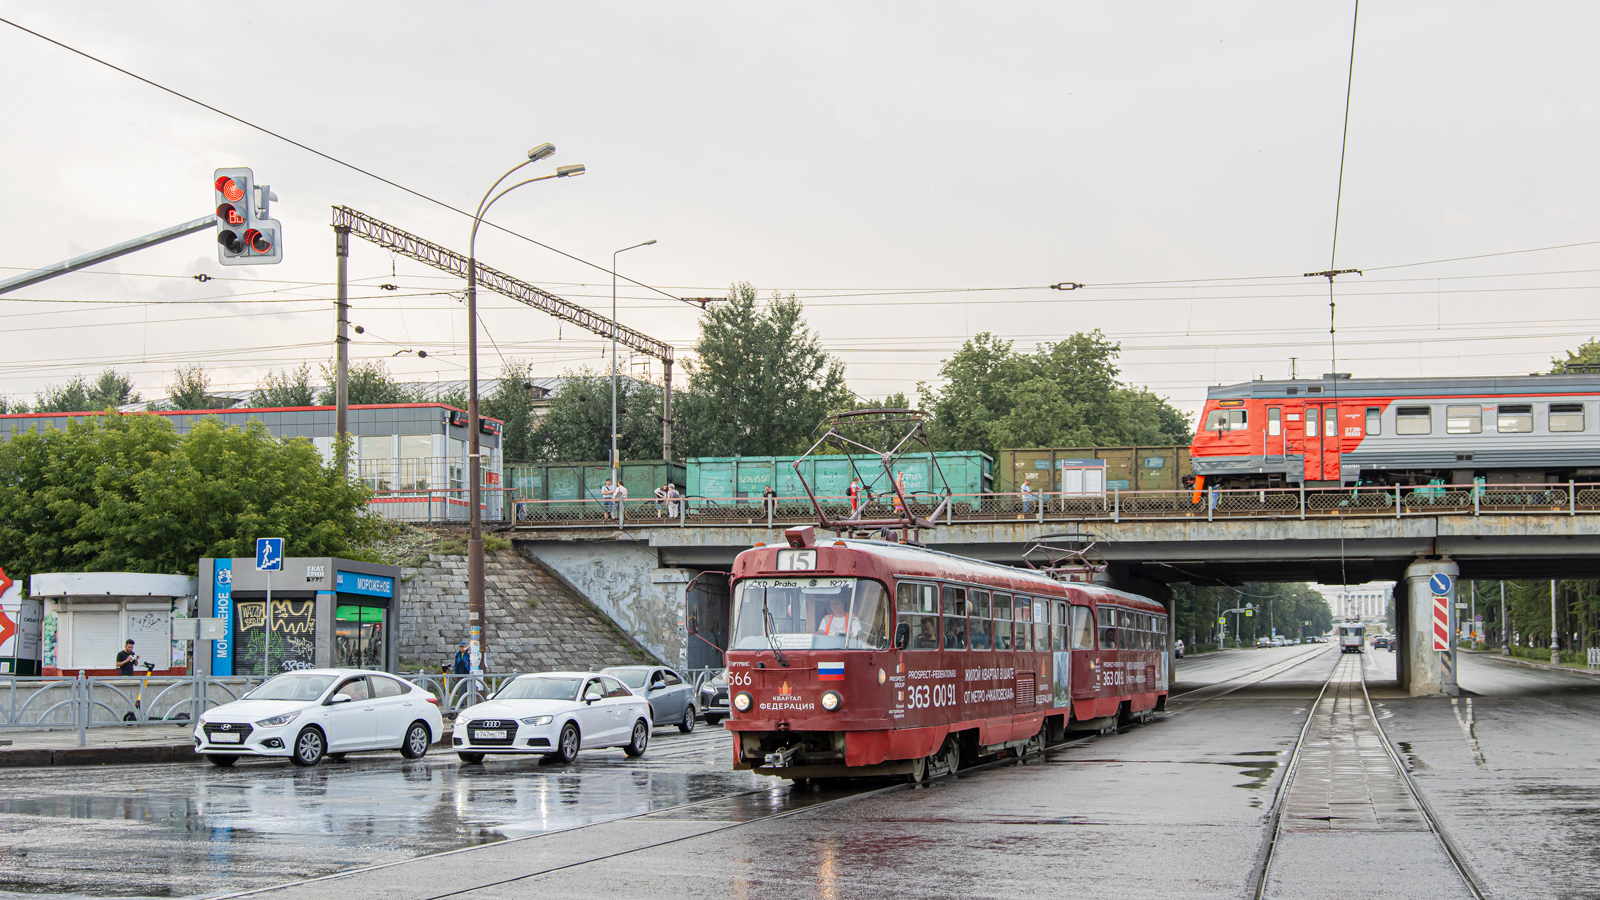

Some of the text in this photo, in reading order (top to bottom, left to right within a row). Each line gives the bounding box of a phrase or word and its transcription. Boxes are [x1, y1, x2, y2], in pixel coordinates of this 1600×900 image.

[788, 552, 810, 570] 15
[357, 578, 390, 593] МОРОЖЕНОЕ
[774, 580, 797, 588] Praha
[981, 668, 1000, 681] КВАРТАЛ
[907, 685, 930, 709] 363
[970, 690, 986, 704] МЕТРО
[759, 702, 815, 711] ФЕДЕРАЦИЯ
